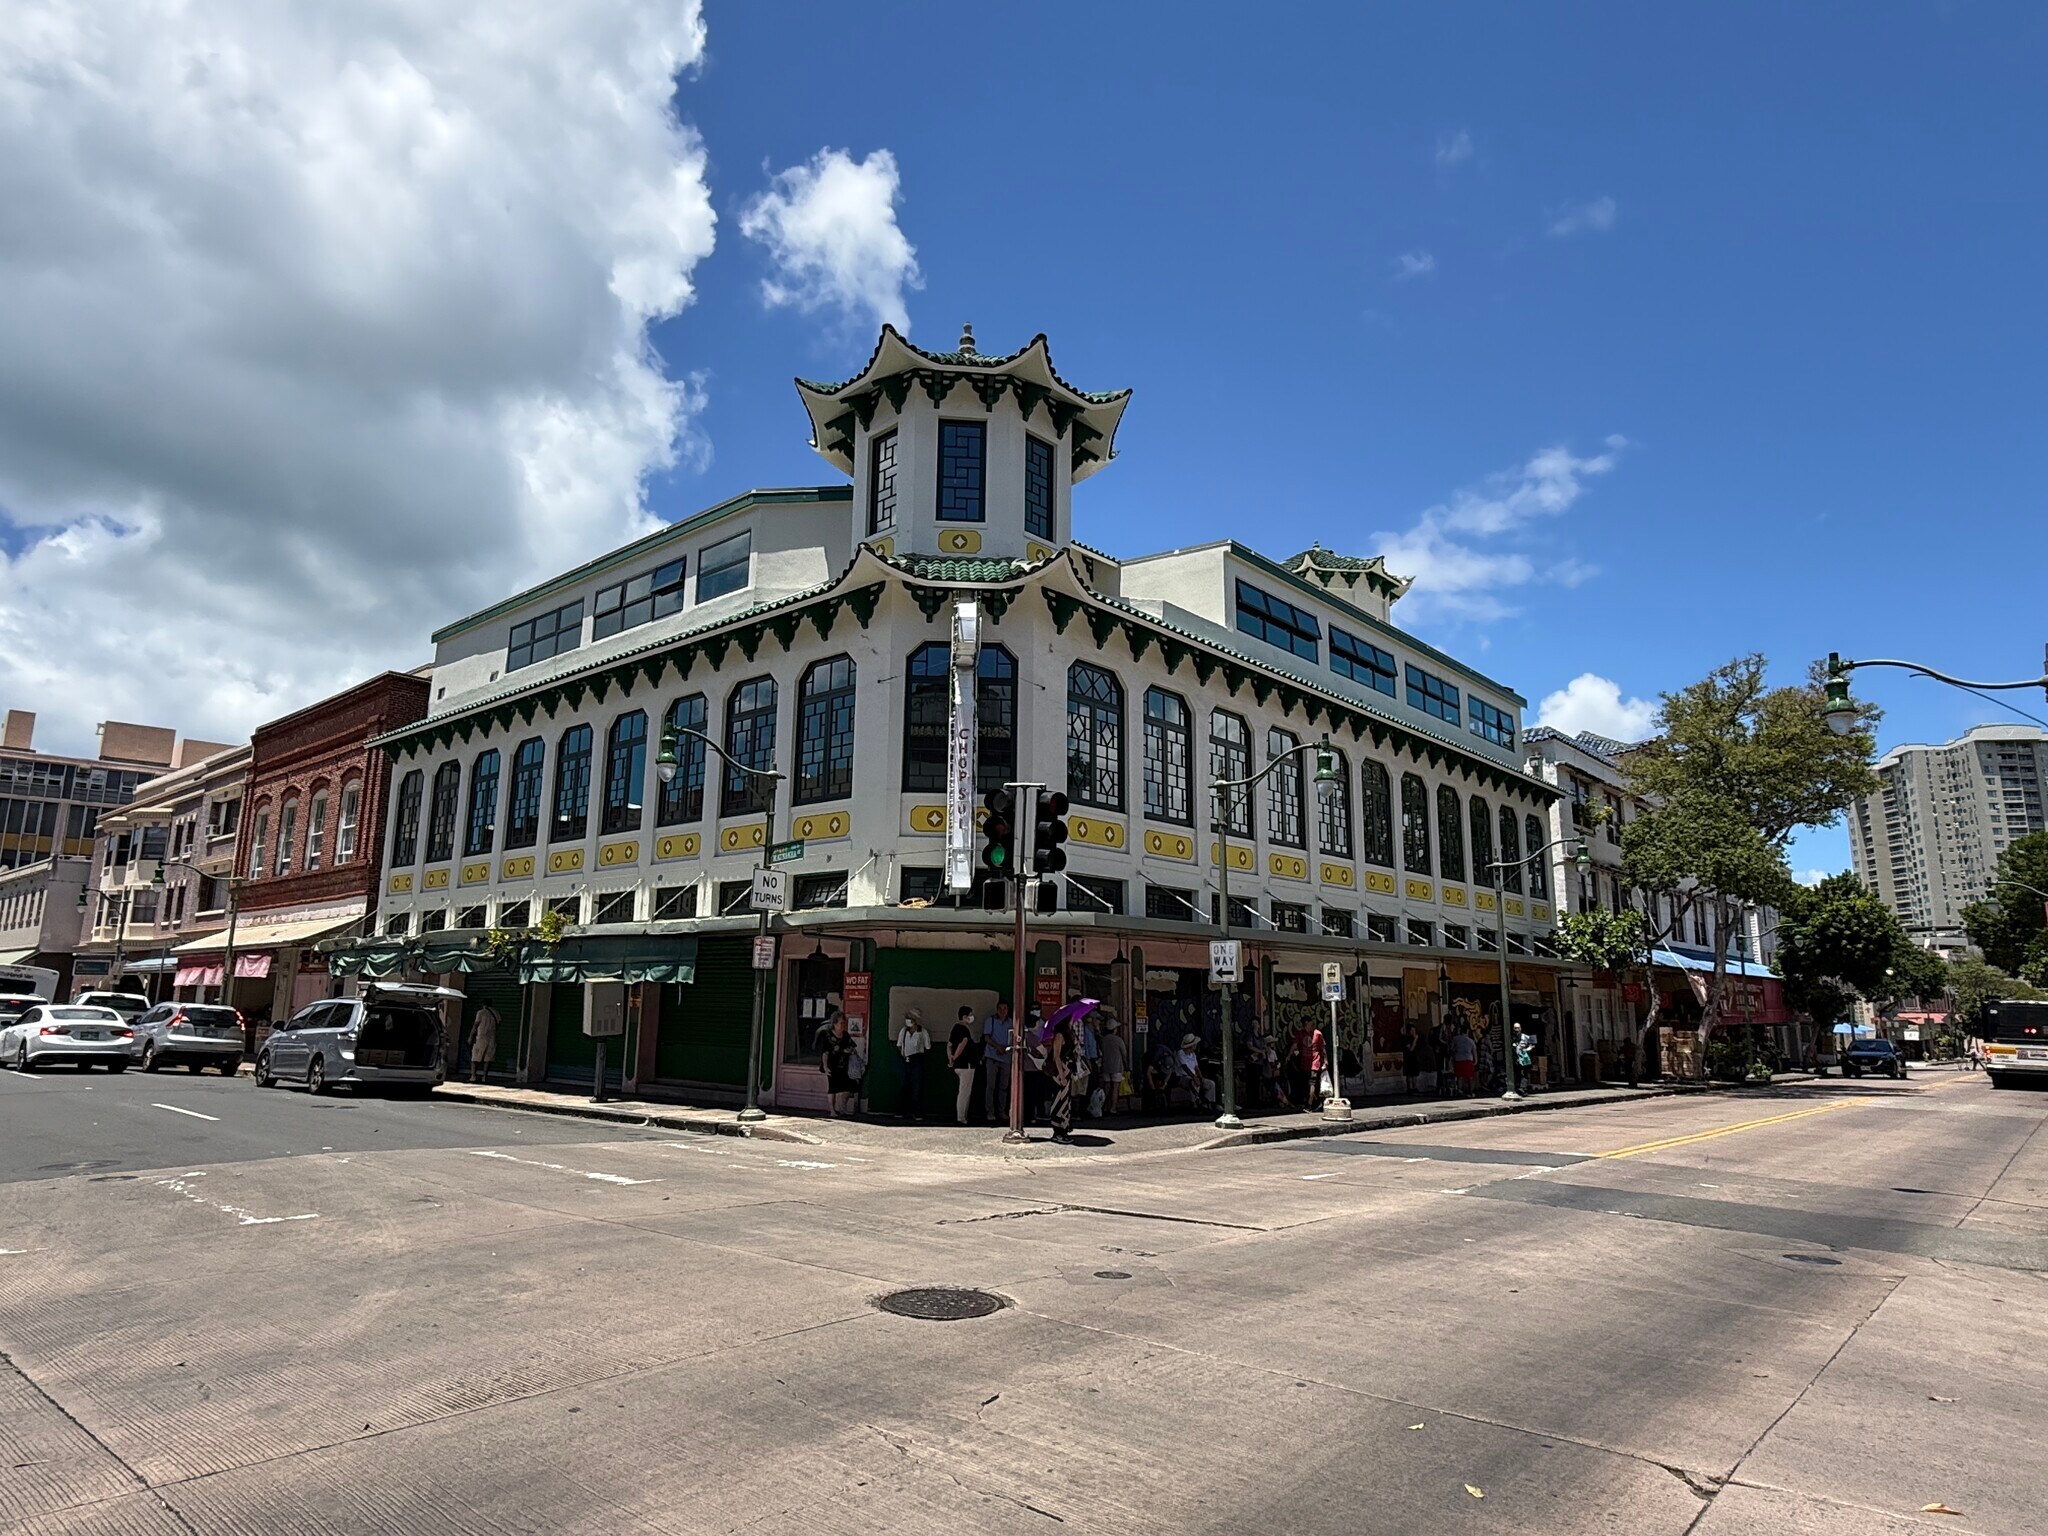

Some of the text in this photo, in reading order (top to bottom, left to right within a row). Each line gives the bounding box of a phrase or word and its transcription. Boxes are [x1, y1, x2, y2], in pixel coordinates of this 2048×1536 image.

[958, 728, 969, 781] CHOP
[762, 875, 778, 889] NO
[754, 891, 783, 905] TURNS
[1213, 944, 1234, 955] ONE
[1213, 956, 1234, 966] WAY
[846, 976, 868, 985] WO FAT
[1038, 981, 1061, 990] WO FAT
